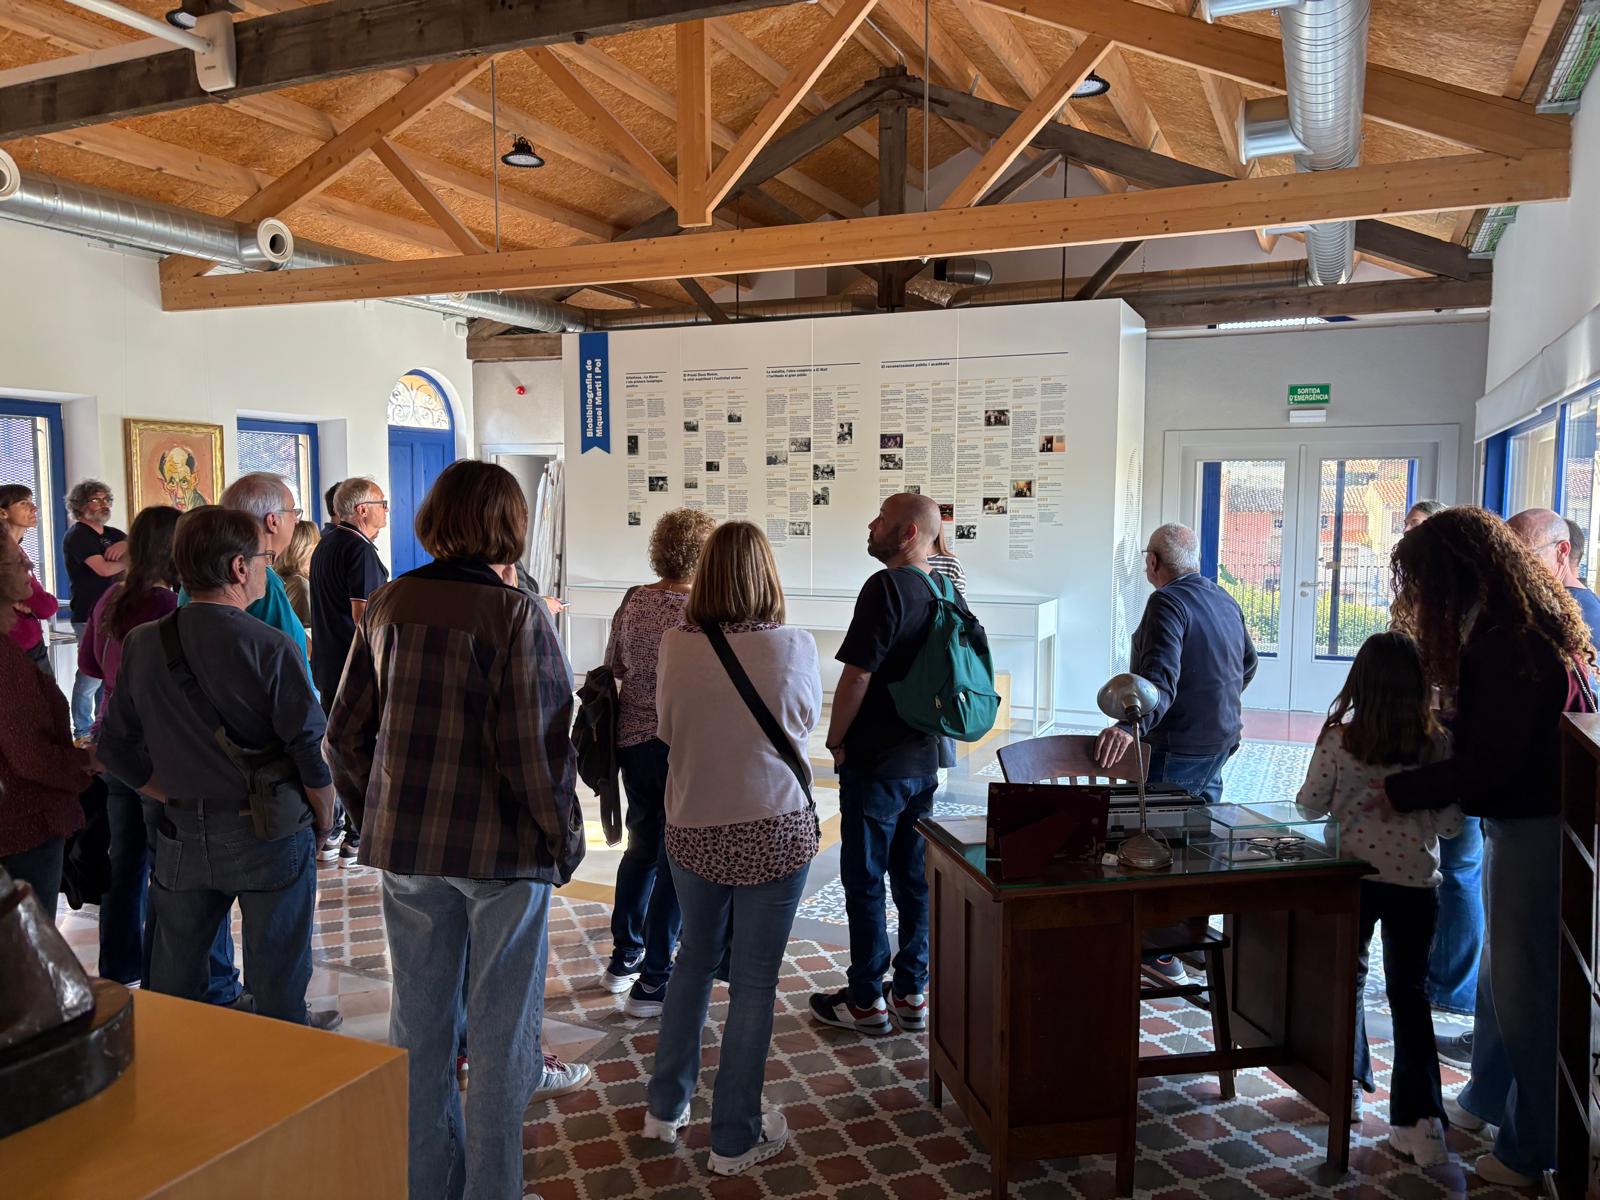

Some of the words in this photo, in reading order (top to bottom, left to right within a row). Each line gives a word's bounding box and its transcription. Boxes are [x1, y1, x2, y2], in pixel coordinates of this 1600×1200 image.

[594, 359, 602, 373] Pol
[585, 372, 594, 438] Biobibliografia
[594, 381, 603, 405] Martí
[595, 407, 604, 437] Miquel
